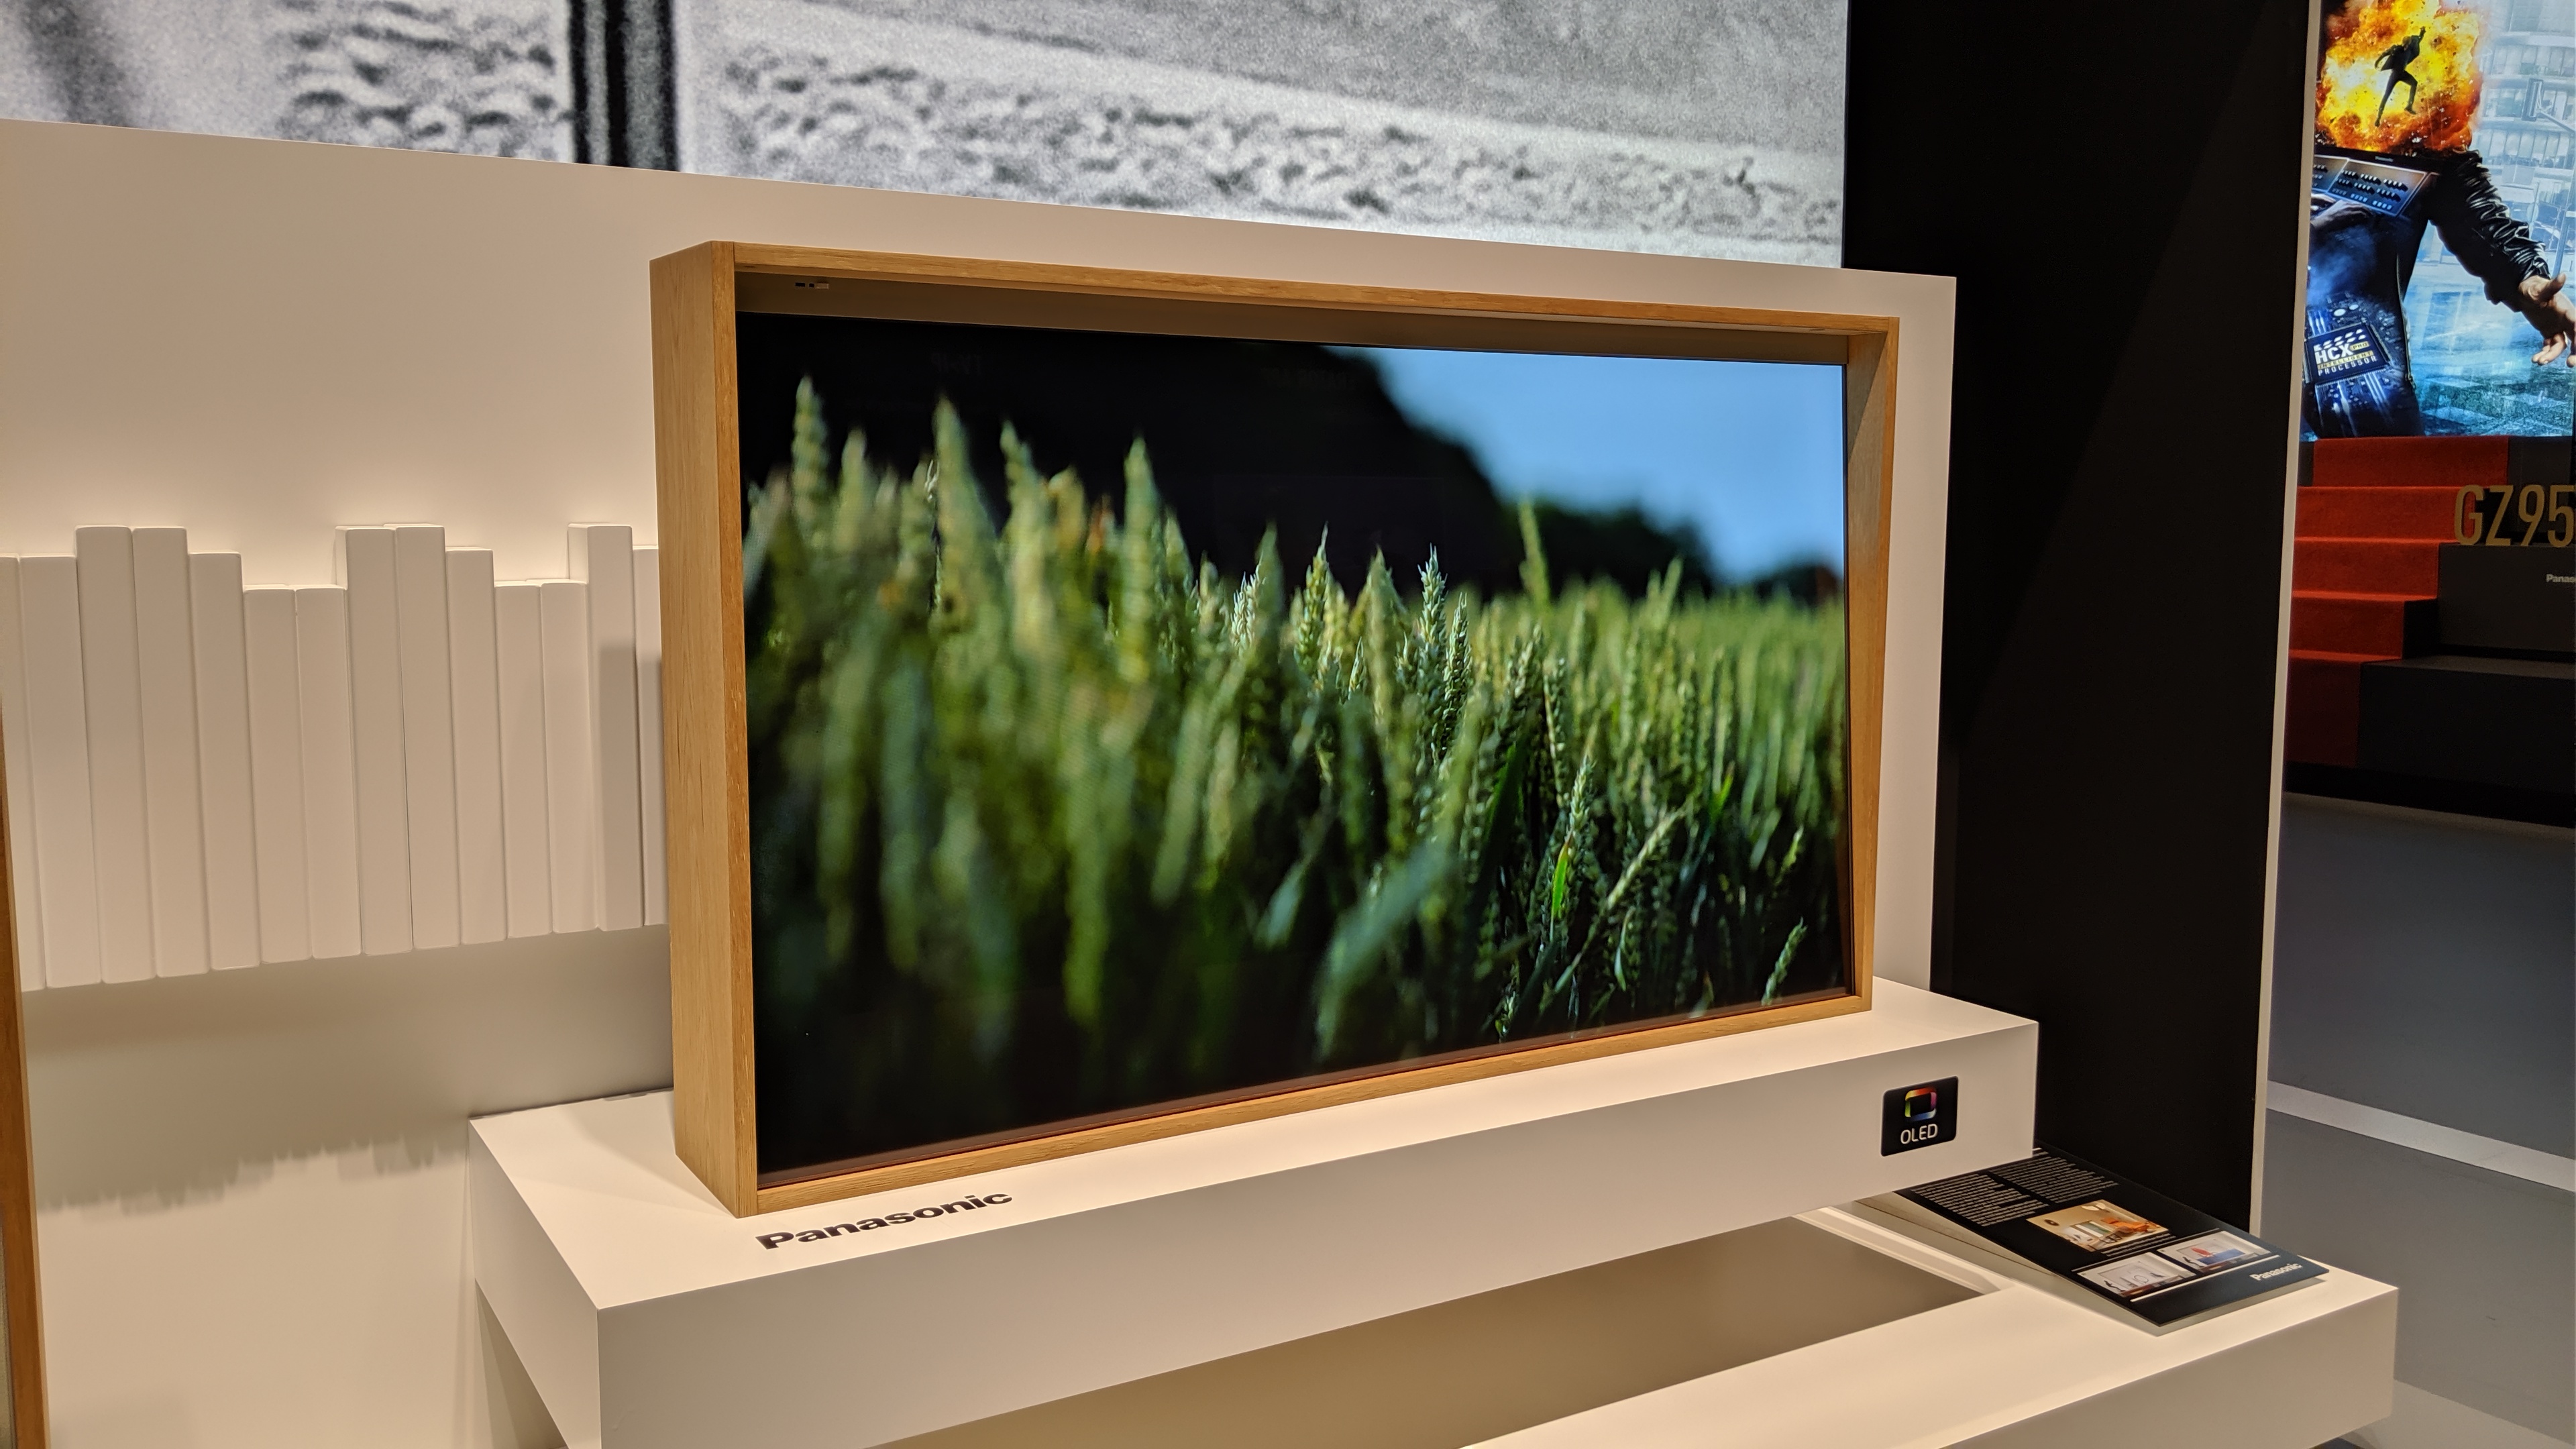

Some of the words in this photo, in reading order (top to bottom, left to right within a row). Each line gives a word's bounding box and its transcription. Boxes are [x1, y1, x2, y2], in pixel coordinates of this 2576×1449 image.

[2314, 343, 2354, 364] HCX
[2352, 342, 2369, 350] PRO
[2318, 352, 2373, 369] INTELLIGENT
[2318, 356, 2377, 377] PROCESSOR
[2454, 484, 2575, 547] GZ95
[2546, 574, 2576, 583] Panas
[1900, 1124, 1939, 1144] OLED
[755, 1193, 1013, 1250] Panasonic
[2249, 1262, 2303, 1281] Panasonic
